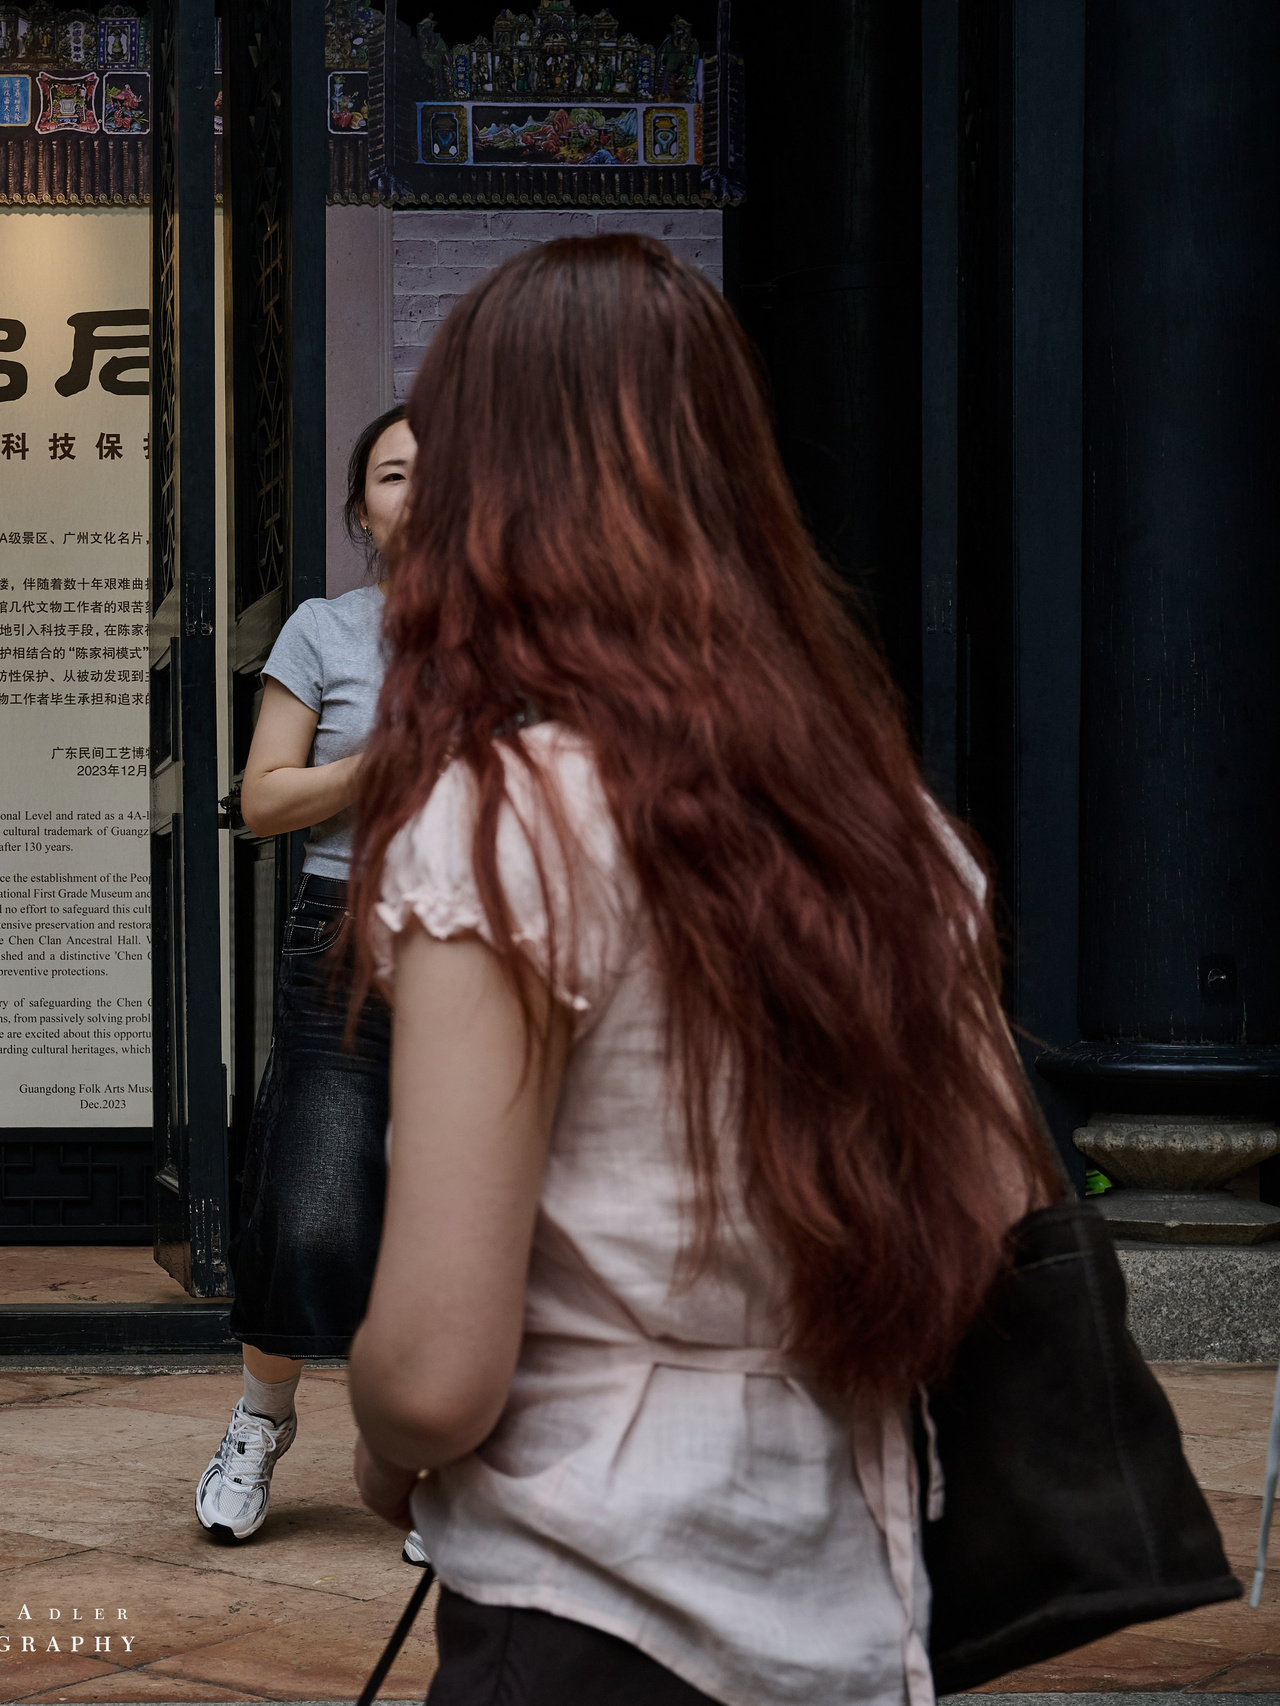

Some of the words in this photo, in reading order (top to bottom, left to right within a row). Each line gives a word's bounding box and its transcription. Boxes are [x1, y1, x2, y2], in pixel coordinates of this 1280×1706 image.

[76, 764, 148, 777] 2023年12月
[25, 810, 52, 820] Level
[55, 810, 74, 820] and
[76, 810, 102, 820] rated
[2, 826, 40, 836] cultural
[43, 826, 93, 836] trademark
[96, 826, 109, 836] of
[25, 842, 42, 852] 130
[44, 844, 73, 854] years.
[13, 873, 28, 883] the
[30, 873, 97, 883] establishment
[99, 873, 112, 883] of
[112, 873, 128, 883] the
[33, 888, 56, 898] First
[58, 888, 88, 898] Grade
[90, 888, 133, 898] Museum
[5, 906, 18, 914] no
[20, 904, 47, 914] effort
[50, 905, 60, 914] to
[62, 904, 110, 916] safeguard
[112, 904, 130, 914] this
[35, 920, 95, 932] preservation
[97, 920, 116, 930] and
[8, 935, 34, 945] Chen
[38, 935, 62, 945] Clan
[66, 935, 112, 945] Ancestral
[118, 935, 141, 945] Hall.
[27, 951, 46, 961] and
[49, 953, 56, 961] a
[59, 951, 110, 961] distinctive
[114, 951, 143, 961] 'Chen
[51, 966, 108, 979] protections.
[13, 998, 26, 1008] of
[28, 998, 92, 1010] safeguarding
[96, 998, 112, 1008] the
[116, 998, 143, 1008] Chen
[14, 1013, 37, 1023] from
[39, 1013, 85, 1026] passively
[87, 1013, 123, 1026] solving
[24, 1028, 60, 1038] excited
[63, 1028, 90, 1038] about
[93, 1028, 111, 1038] this
[31, 1044, 68, 1054] cultural
[71, 1044, 118, 1057] heritages,
[121, 1044, 151, 1054] which
[19, 1084, 76, 1096] Guangdong
[79, 1084, 101, 1094] Folk
[104, 1084, 125, 1094] Arts
[80, 1099, 126, 1109] Dec.2023
